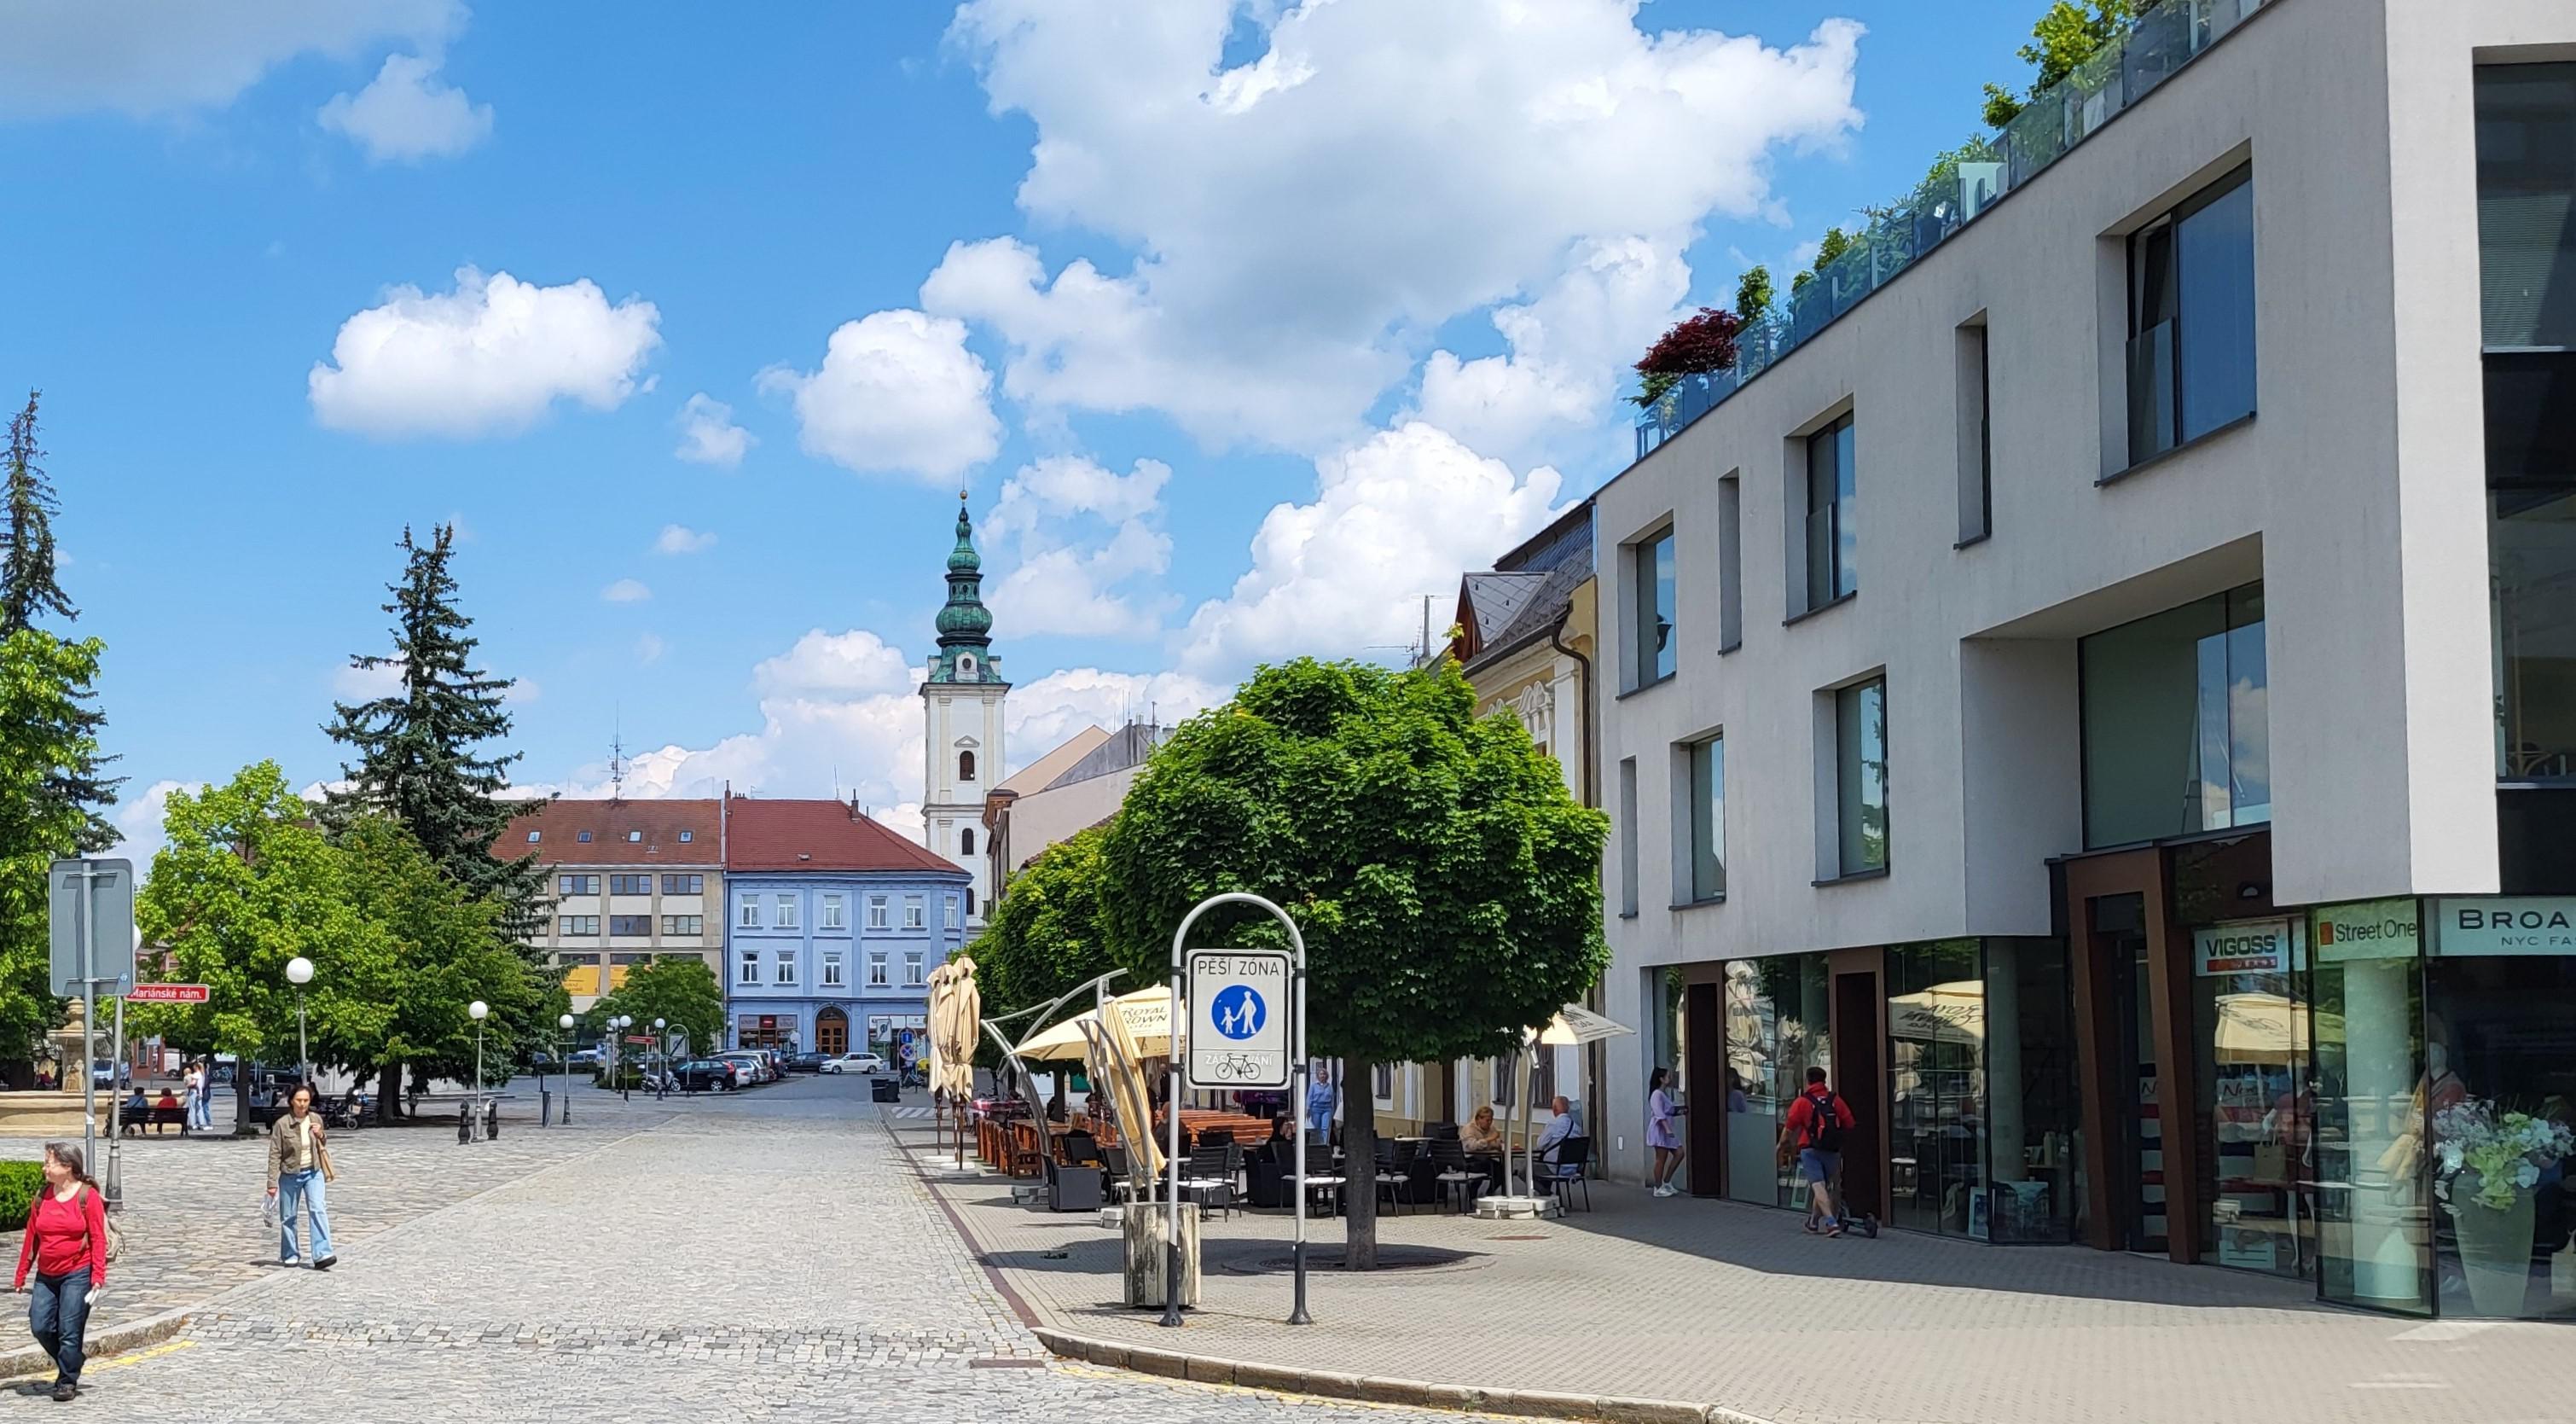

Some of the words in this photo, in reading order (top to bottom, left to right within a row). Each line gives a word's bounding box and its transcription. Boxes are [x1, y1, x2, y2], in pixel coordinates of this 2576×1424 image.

[2458, 909, 2571, 930] BROA
[2335, 923, 2382, 942] Street
[2384, 919, 2417, 938] One
[2206, 934, 2277, 956] VIGOSS
[2501, 936, 2539, 946] NYC
[1198, 957, 1233, 975] PĚŠÍ
[1239, 957, 1280, 976] ZÓNA
[179, 988, 202, 999] nám.
[1122, 1006, 1168, 1018] ROYAL
